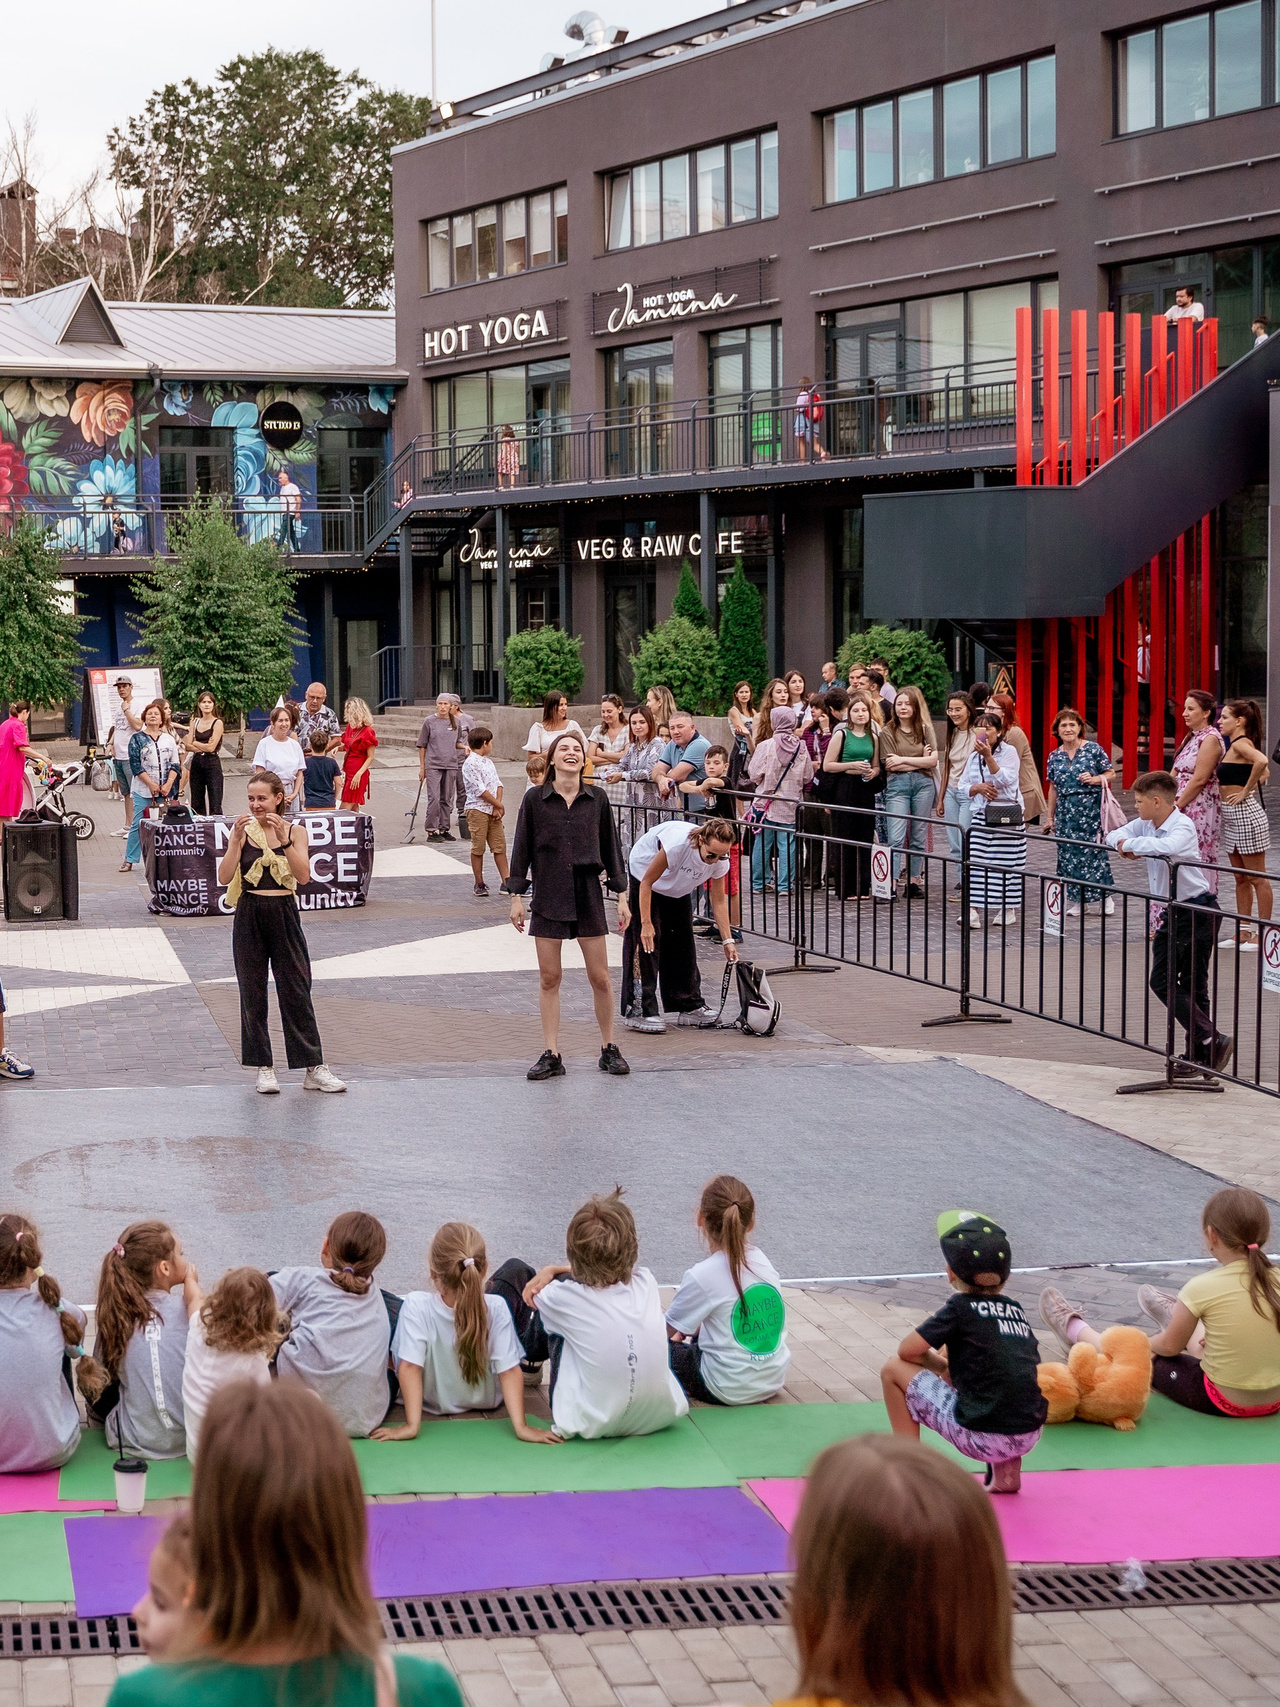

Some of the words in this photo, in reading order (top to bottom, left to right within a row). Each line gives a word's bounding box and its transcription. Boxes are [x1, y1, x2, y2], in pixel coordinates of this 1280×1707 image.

[607, 282, 739, 333] Jamuna
[643, 294, 665, 309] HOT
[666, 288, 696, 303] YOGA
[424, 324, 473, 359] HOT
[478, 309, 550, 348] YOGA
[263, 420, 292, 431] STUDIO
[577, 538, 615, 560] VEG
[621, 536, 635, 559] &
[641, 534, 684, 558] RAW
[688, 531, 744, 556] CFE
[154, 833, 206, 847] DANCE
[154, 847, 206, 857] Community
[157, 878, 208, 892] MAYBE
[158, 892, 209, 905] DANCE
[738, 1295, 778, 1321] MAYBE
[150, 1341, 160, 1379] BLACK
